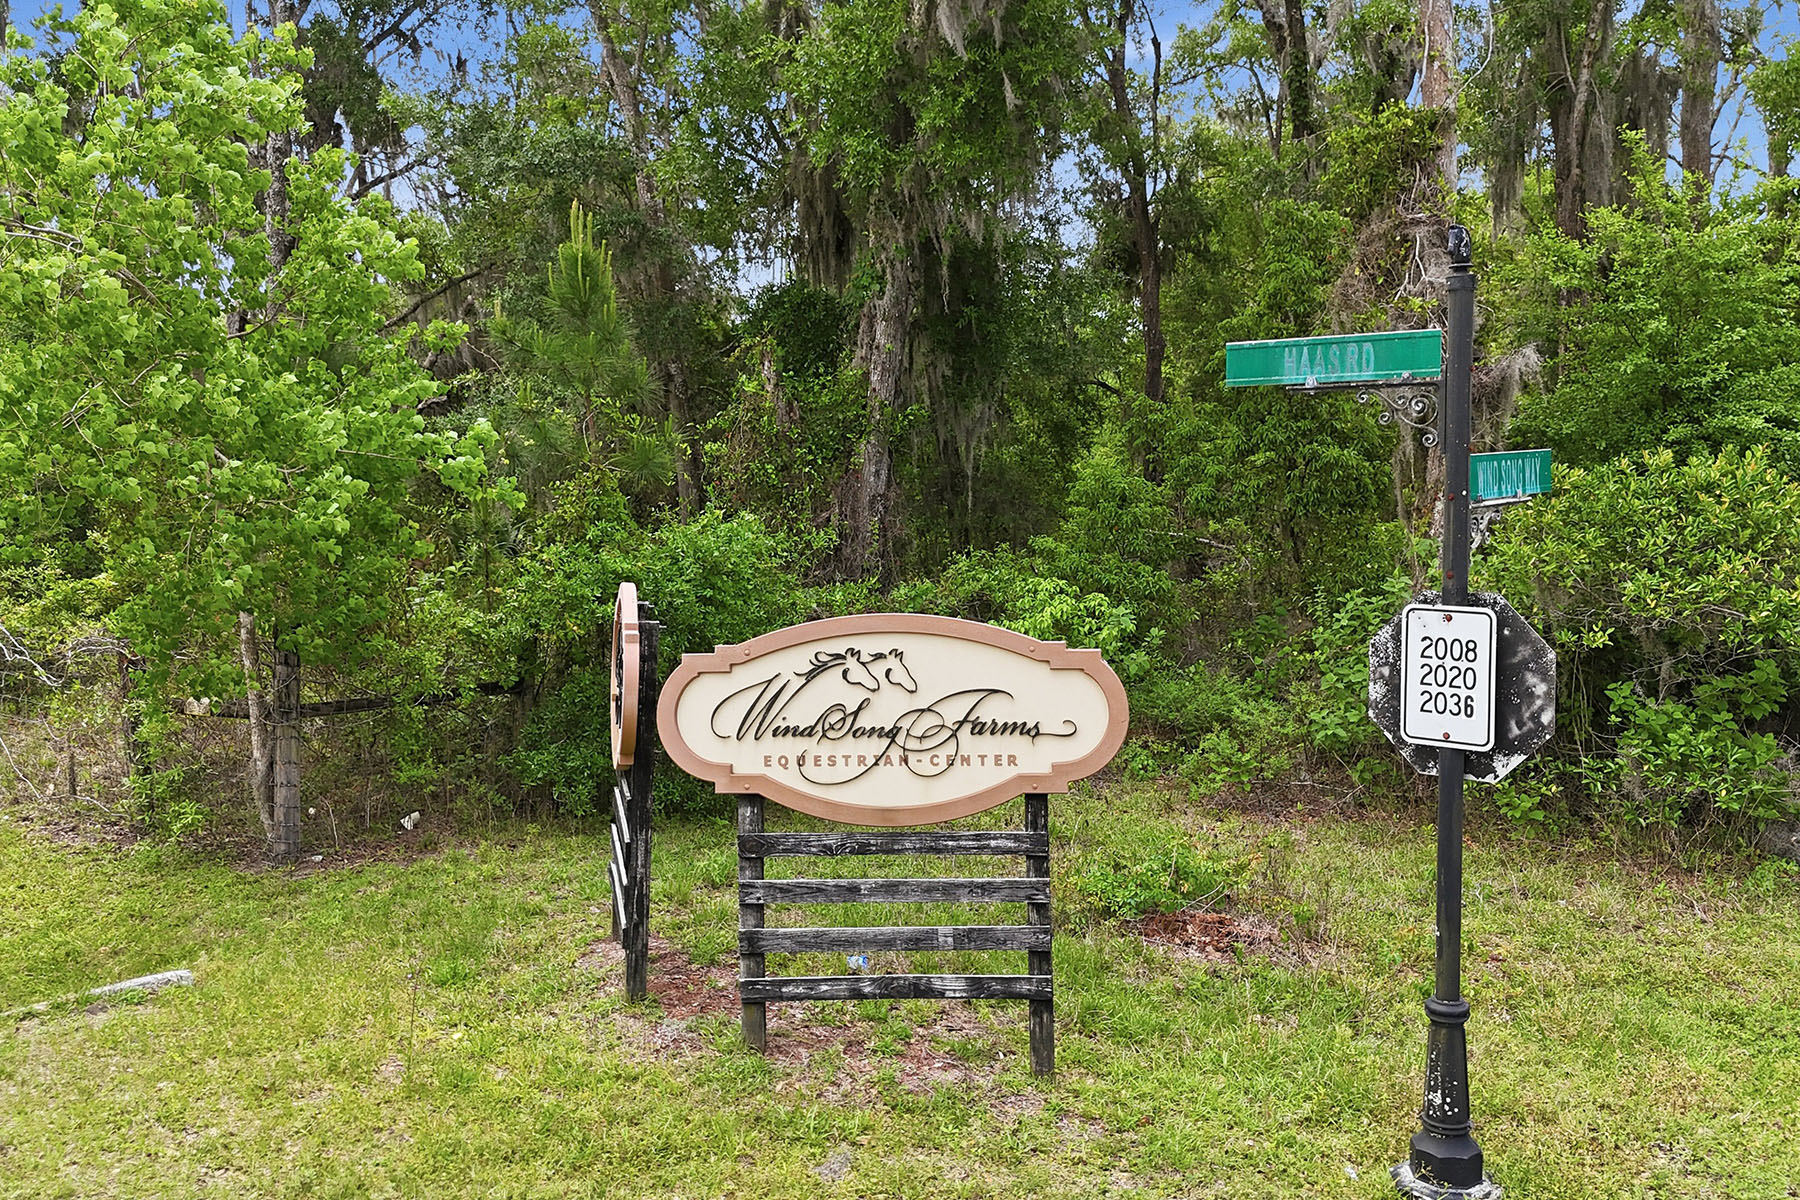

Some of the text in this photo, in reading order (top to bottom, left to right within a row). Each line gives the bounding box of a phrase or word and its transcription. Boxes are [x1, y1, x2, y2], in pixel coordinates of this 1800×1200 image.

[1477, 456, 1541, 494] WIND SONG WAY
[1419, 635, 1478, 663] 2008
[1419, 662, 1477, 691] 2020
[1419, 689, 1475, 718] 2036
[893, 688, 1078, 777] Farms
